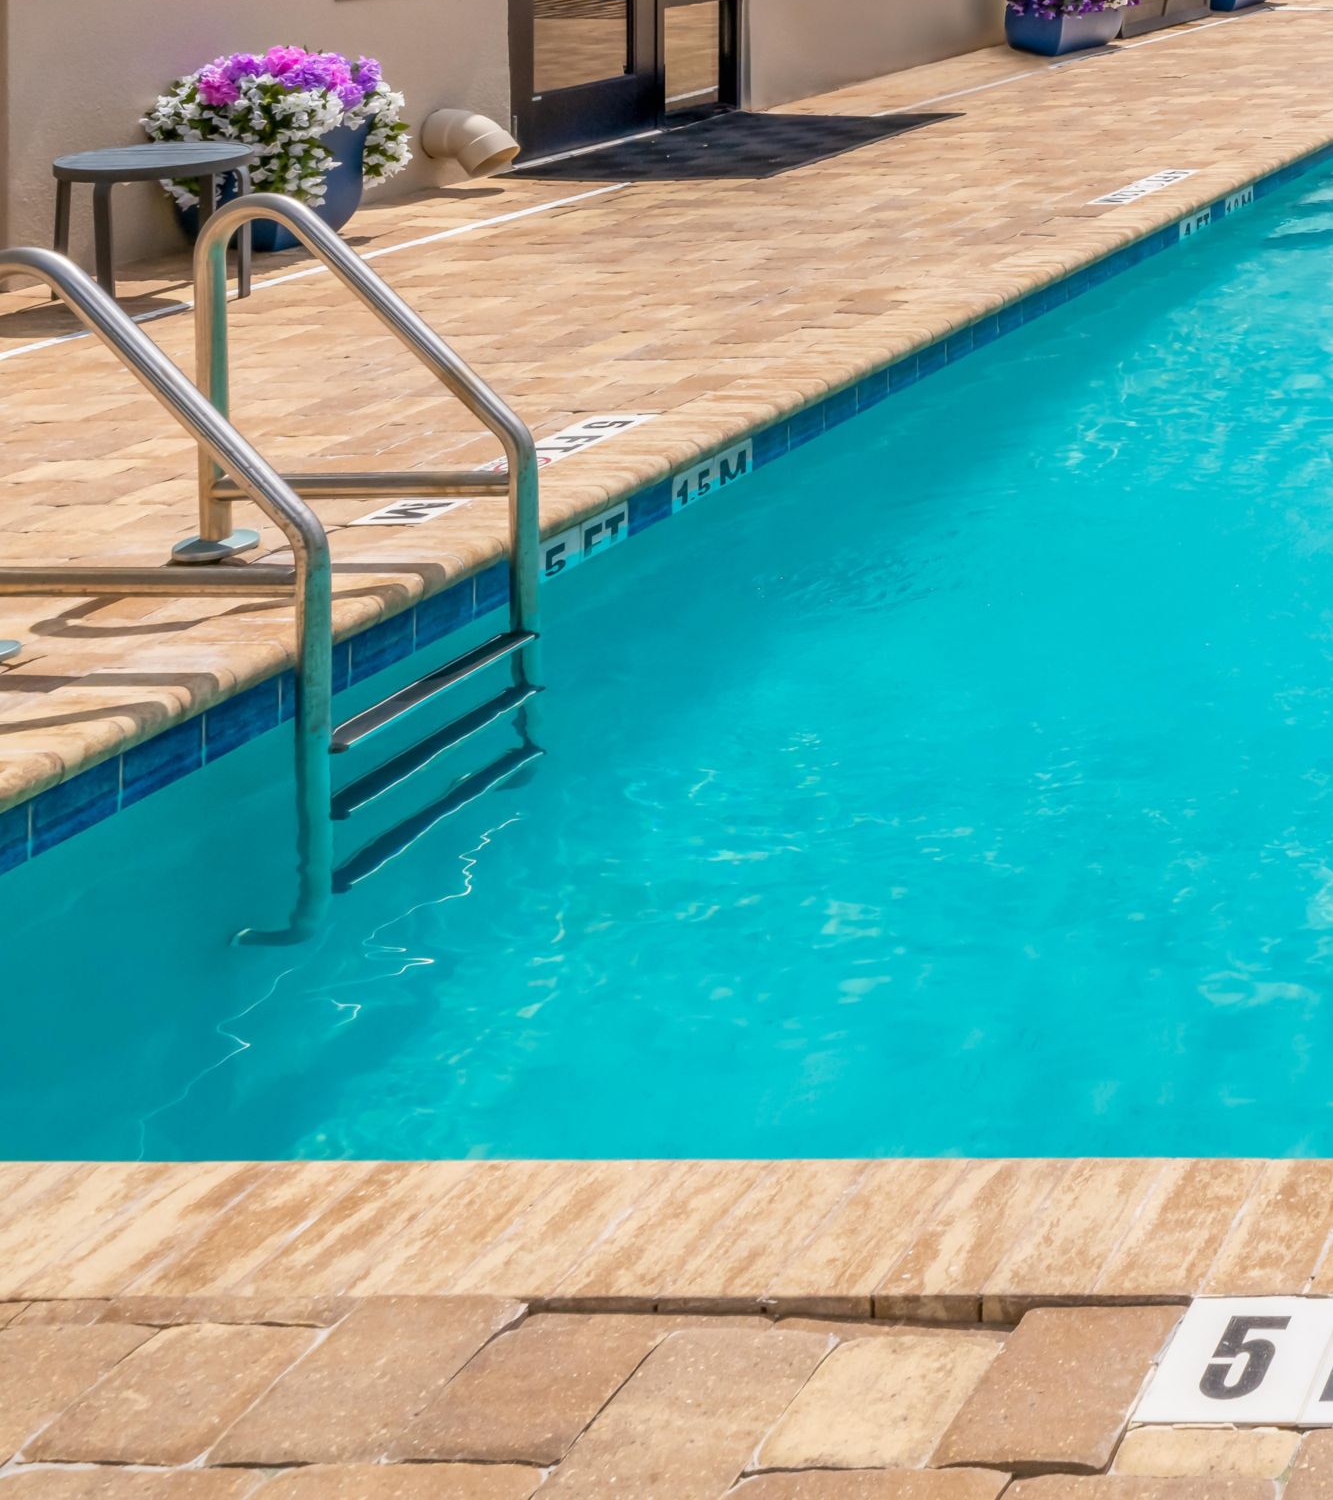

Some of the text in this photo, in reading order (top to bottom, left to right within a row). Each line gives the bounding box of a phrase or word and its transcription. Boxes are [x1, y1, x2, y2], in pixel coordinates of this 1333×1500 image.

[719, 449, 747, 487] M
[545, 511, 625, 577] 5 FT
[1199, 1315, 1292, 1400] 5
